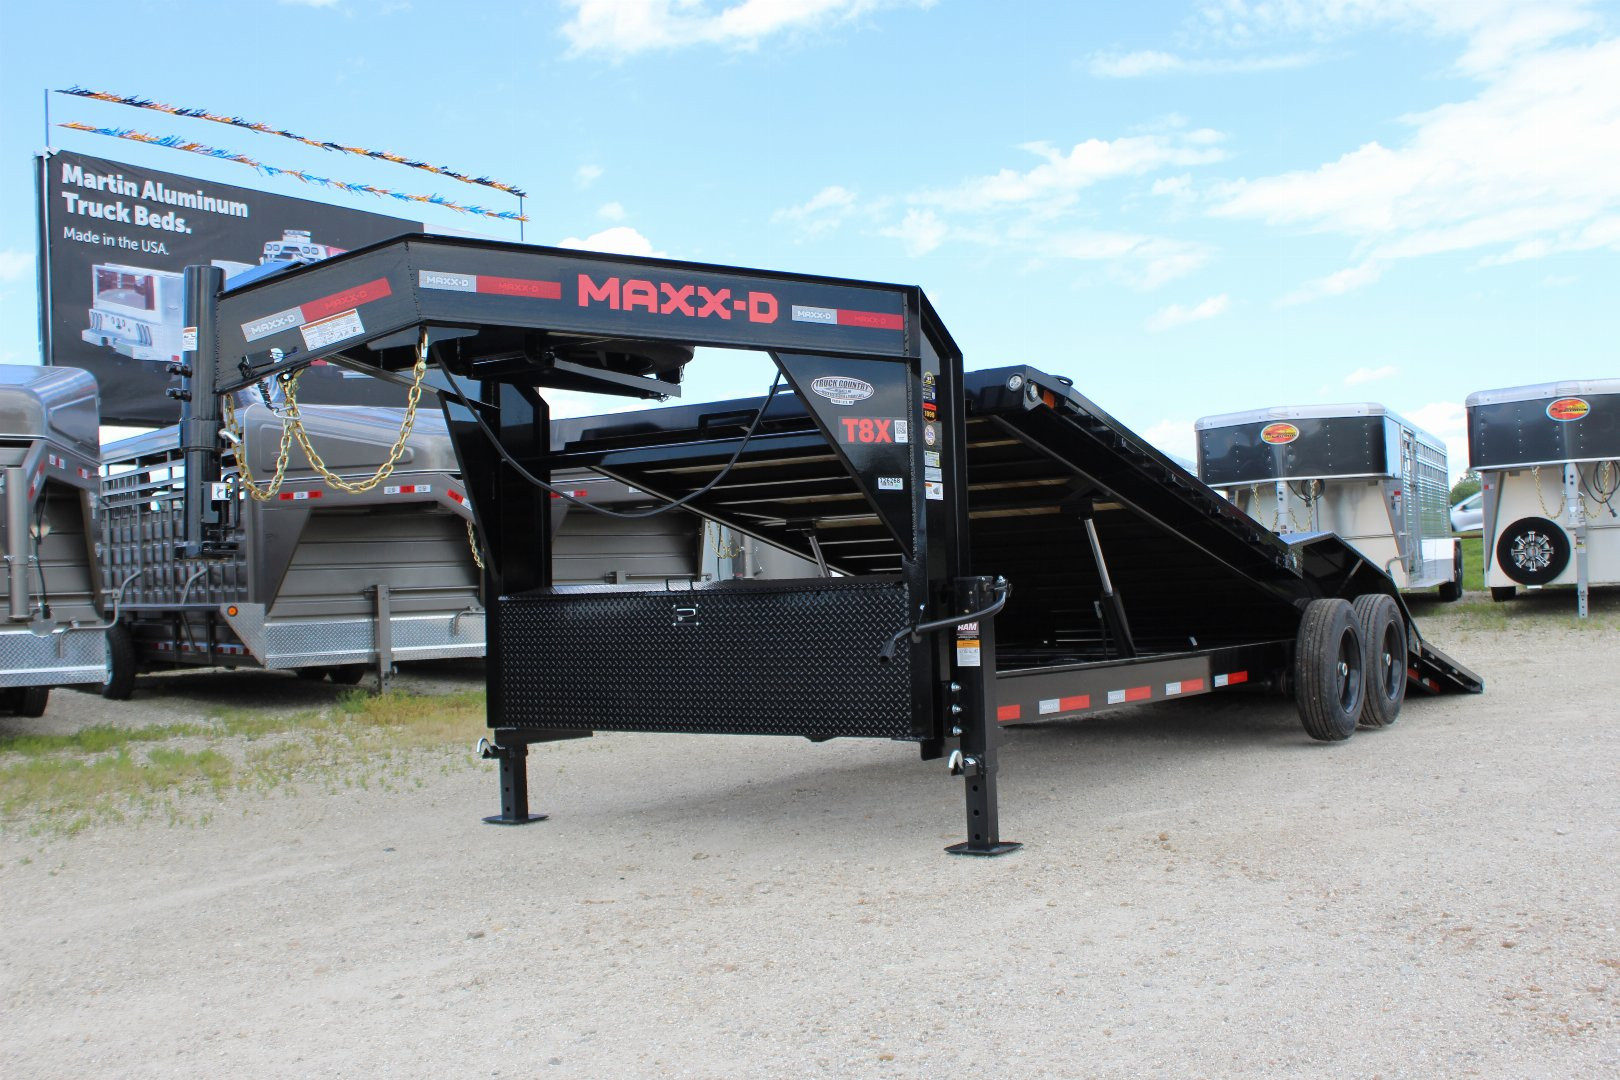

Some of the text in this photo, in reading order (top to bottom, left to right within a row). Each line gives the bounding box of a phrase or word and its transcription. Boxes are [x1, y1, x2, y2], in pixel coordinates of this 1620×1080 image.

[62, 163, 249, 218] Martin Aluminum
[62, 191, 192, 235] Truck Beds.
[63, 226, 169, 255] Made in the USA.
[426, 275, 469, 287] MAXX-D
[578, 274, 779, 324] MAXX-D
[815, 379, 870, 391] TRUCK COUNTRY
[842, 417, 893, 443] T8X
